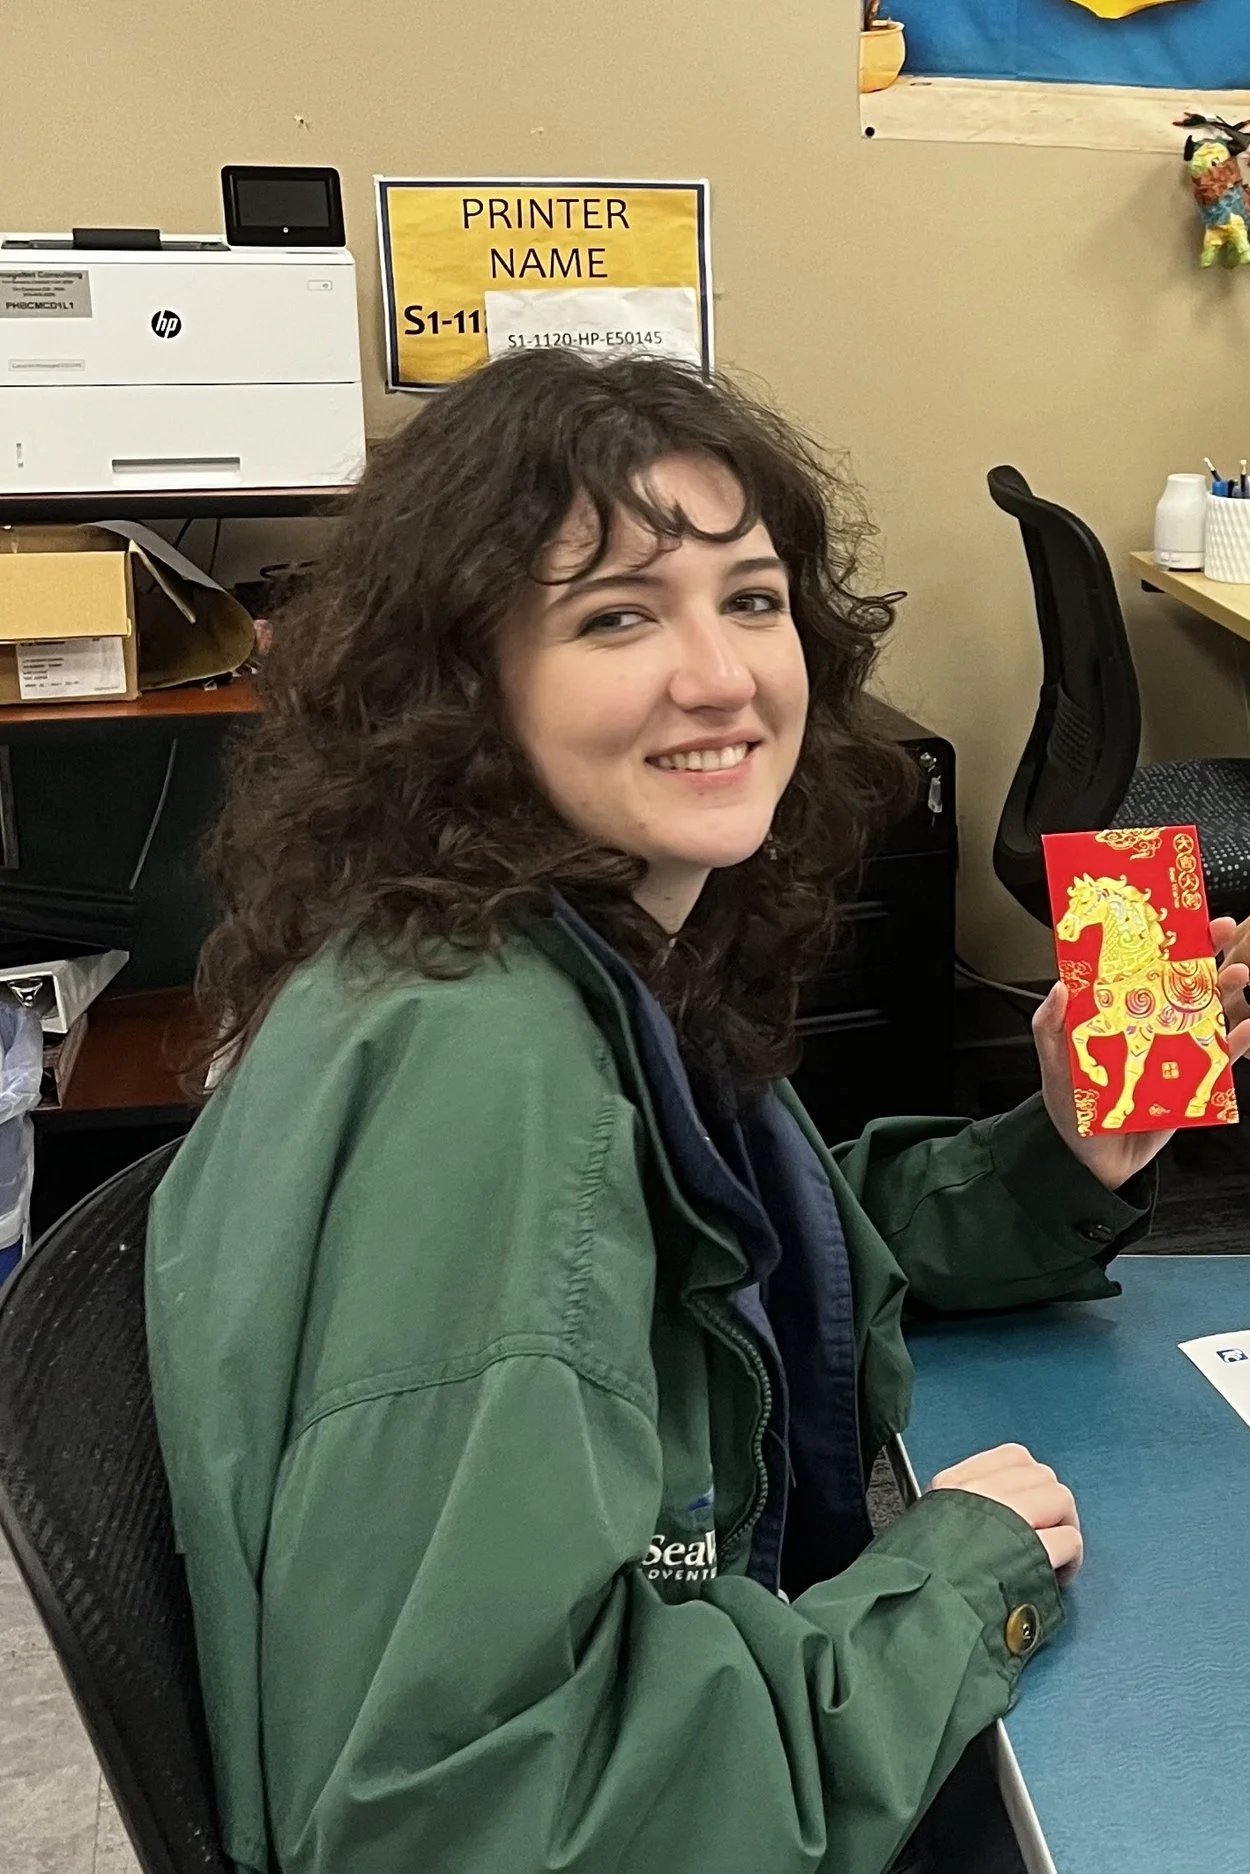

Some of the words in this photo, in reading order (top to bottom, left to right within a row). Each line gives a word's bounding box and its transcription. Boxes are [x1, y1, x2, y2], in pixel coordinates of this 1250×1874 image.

[463, 198, 630, 230] PRINTER
[490, 247, 608, 279] NAME
[154, 310, 180, 339] hp
[403, 304, 487, 336] S1-11
[507, 330, 663, 348] S1-1120-HP-E50145
